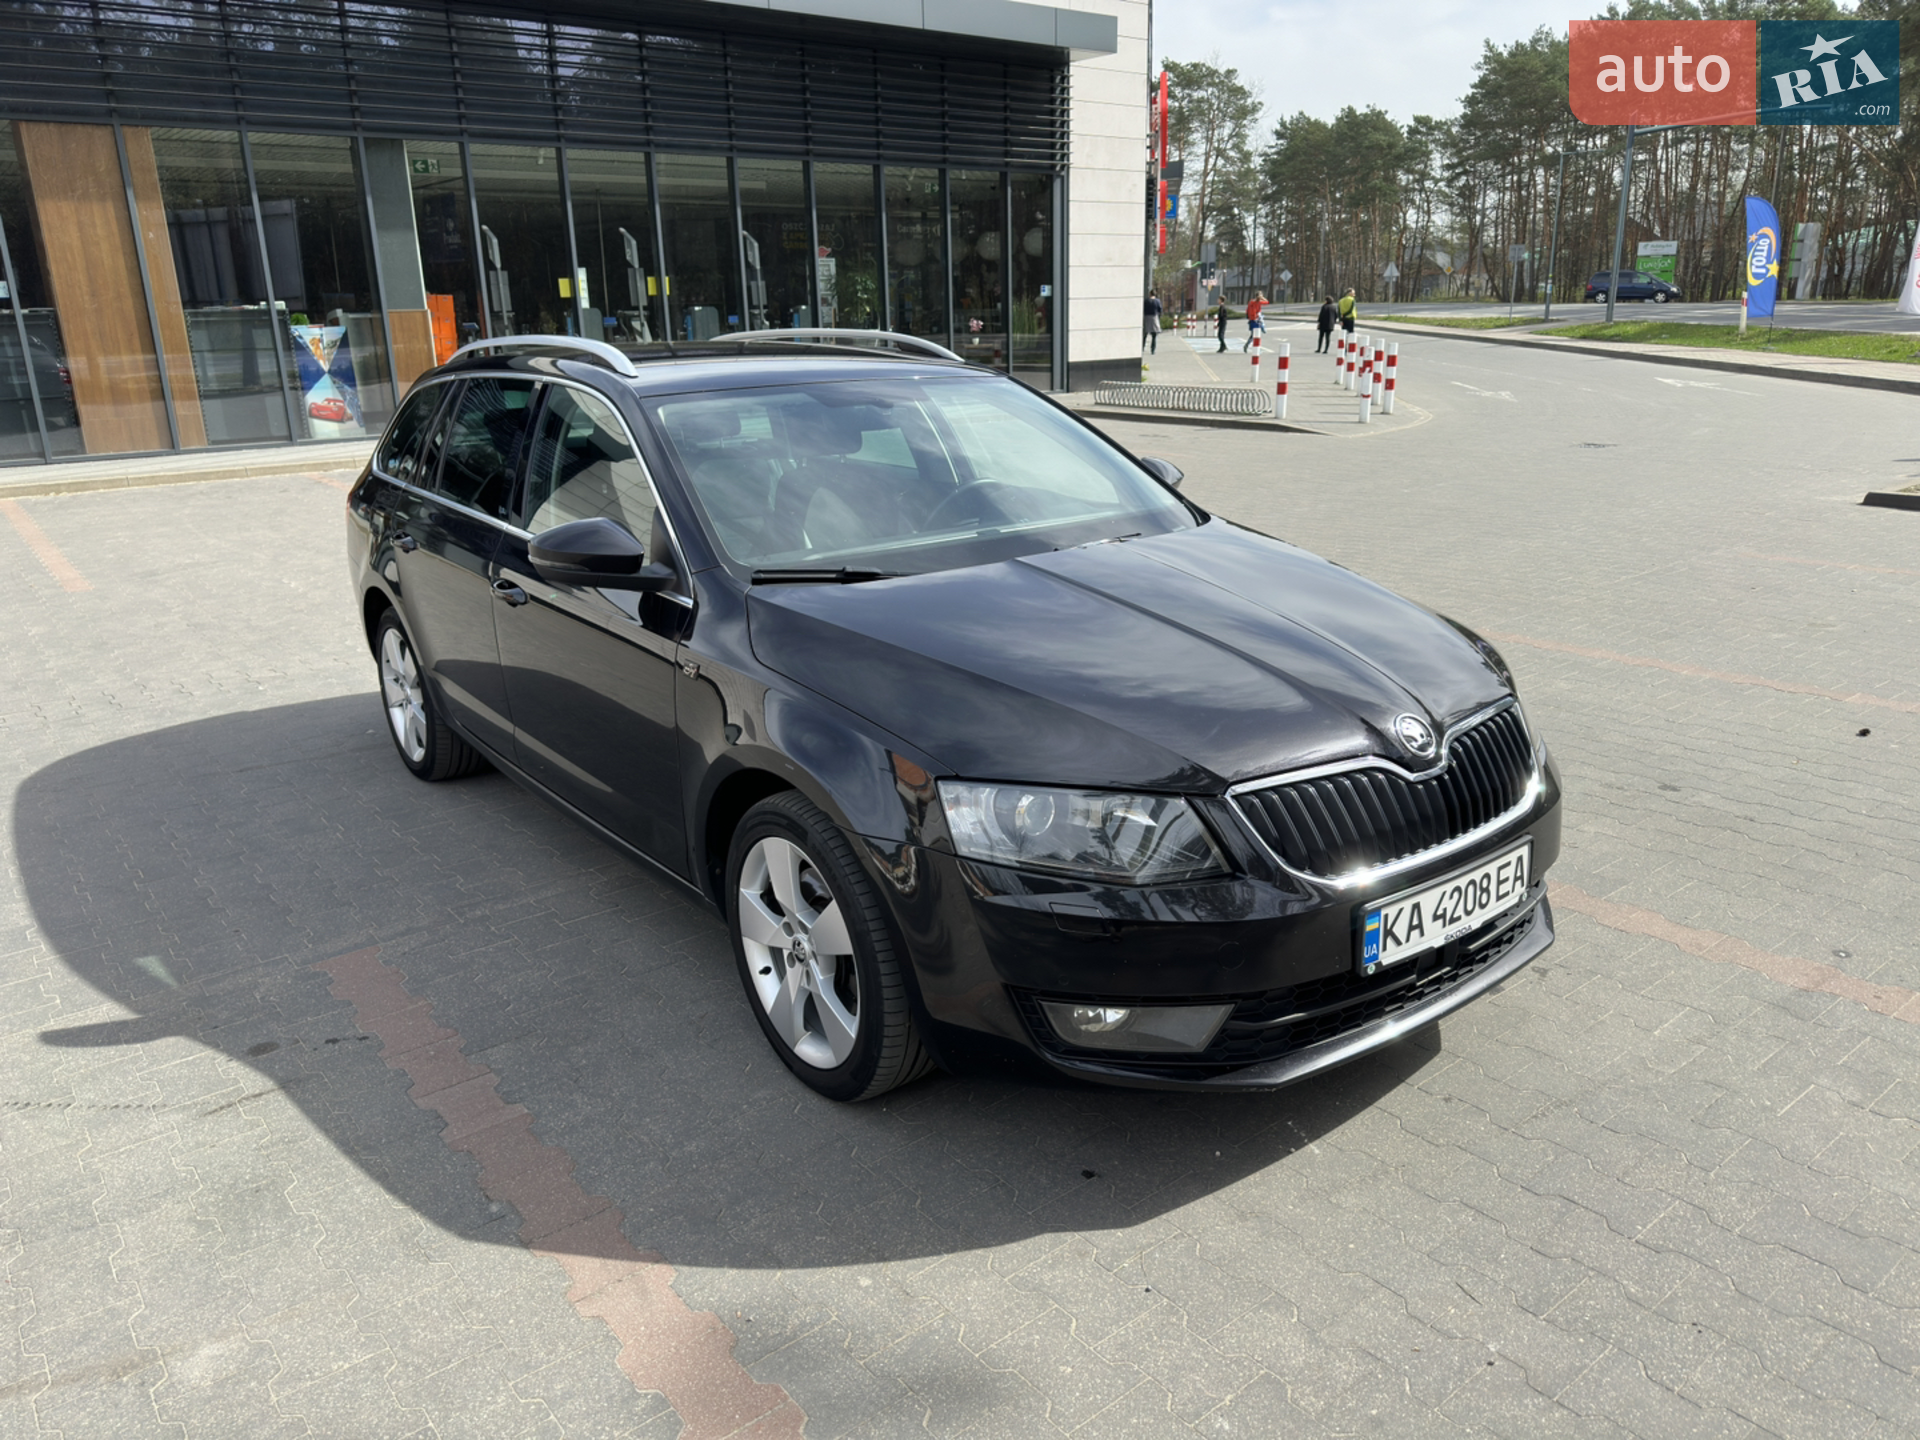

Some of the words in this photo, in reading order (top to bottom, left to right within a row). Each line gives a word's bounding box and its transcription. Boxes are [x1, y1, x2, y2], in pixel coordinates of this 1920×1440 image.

[1381, 901, 1425, 952] KA
[1432, 872, 1491, 929] 4208
[1495, 854, 1525, 902] EA
[1363, 943, 1378, 958] UA
